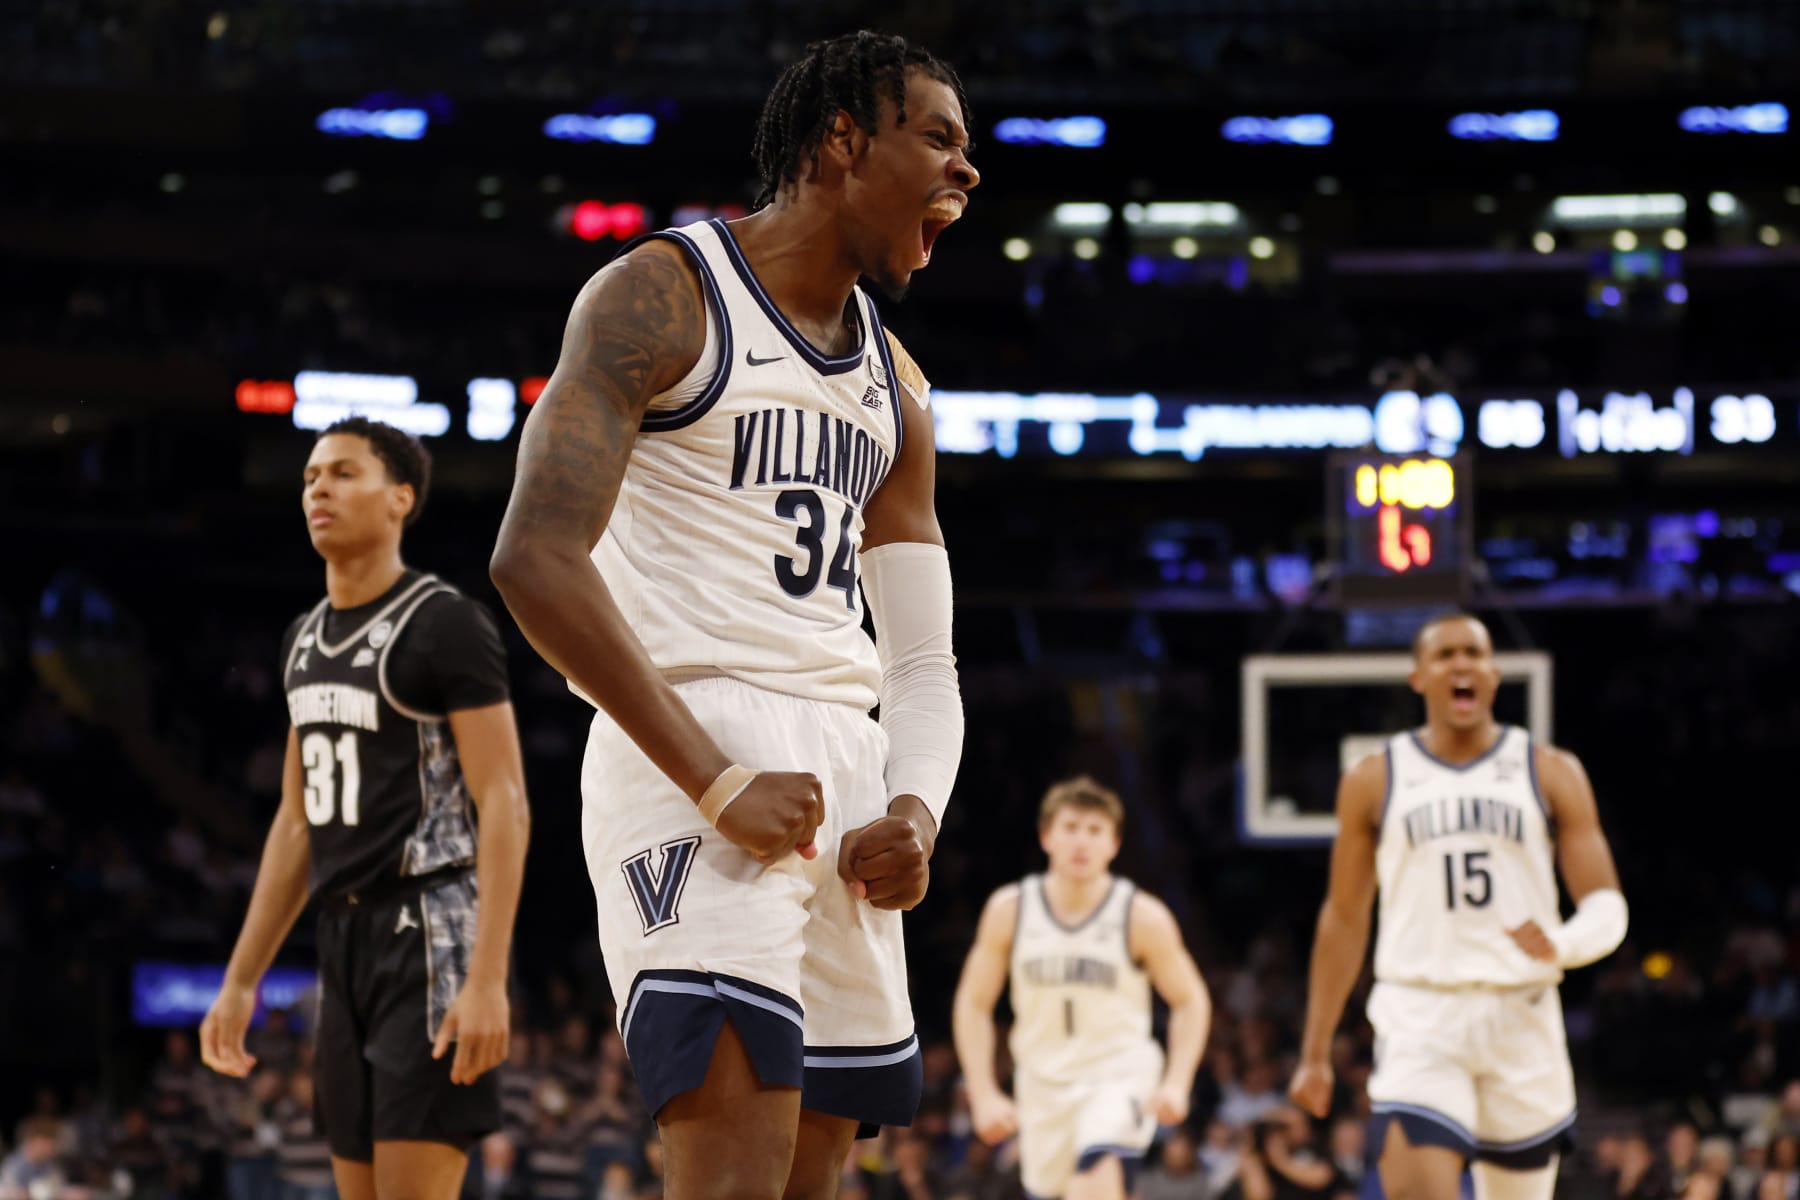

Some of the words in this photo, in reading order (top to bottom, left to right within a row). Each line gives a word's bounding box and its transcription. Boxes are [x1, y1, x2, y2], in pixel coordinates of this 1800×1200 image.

[861, 394, 883, 409] EAST
[866, 386, 879, 399] BIG
[774, 489, 856, 612] 34
[302, 731, 360, 826] 31
[1405, 797, 1524, 849] VILLANOVA
[621, 835, 702, 937] V
[1444, 851, 1492, 912] 15
[1063, 998, 1075, 1038] 1
